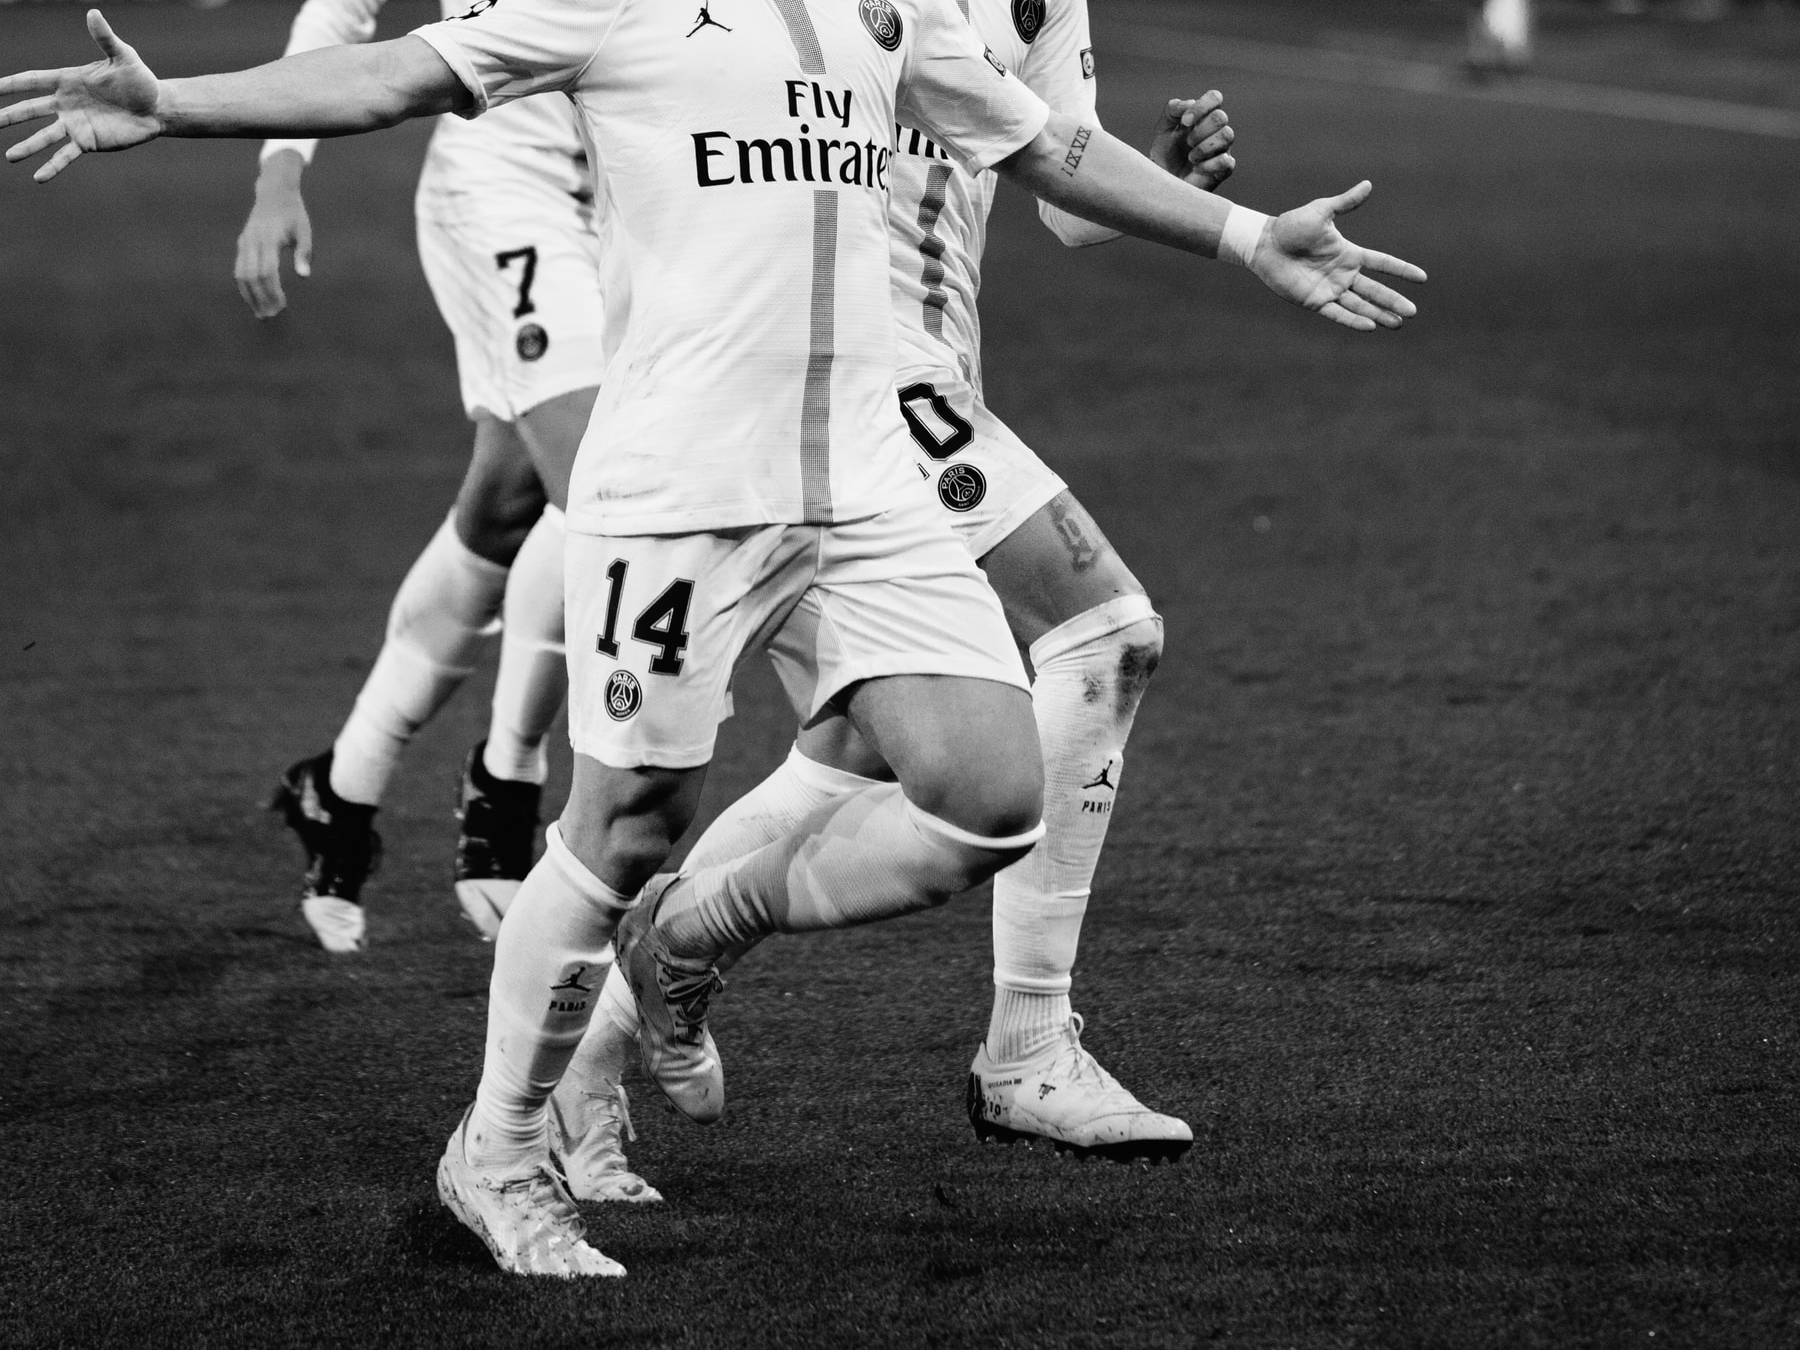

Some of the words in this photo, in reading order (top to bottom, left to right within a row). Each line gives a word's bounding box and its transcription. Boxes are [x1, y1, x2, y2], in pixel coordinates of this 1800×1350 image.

[863, 0, 892, 13] PARIS
[785, 80, 852, 128] Fly
[494, 246, 538, 320] 7
[897, 381, 975, 481] 0
[941, 467, 966, 490] PARIS
[595, 557, 696, 677] 14
[612, 673, 636, 690] PARIS
[1081, 800, 1112, 814] PARIS
[548, 1000, 586, 1012] PARIS
[989, 1101, 1002, 1116] 10
